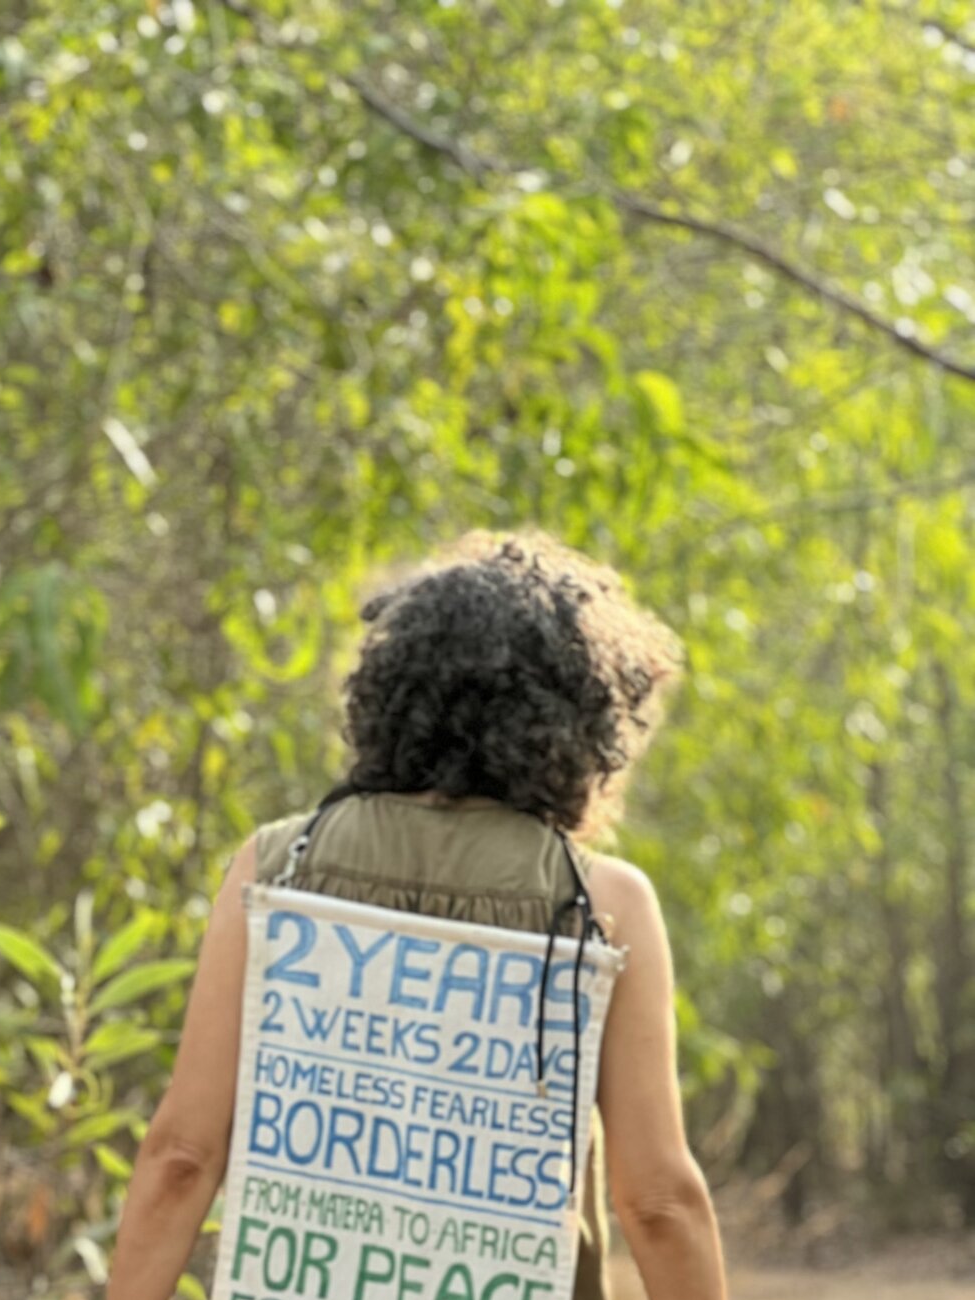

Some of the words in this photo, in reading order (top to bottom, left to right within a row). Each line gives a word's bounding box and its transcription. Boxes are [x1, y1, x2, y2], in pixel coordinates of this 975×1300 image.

[266, 911, 320, 988] 2
[335, 926, 596, 1034] YEARS
[260, 992, 285, 1033] 2
[293, 998, 440, 1064] WEEKS
[449, 1034, 480, 1074] 2
[487, 1039, 576, 1091] DAYS
[257, 1052, 405, 1109] HOMELESS
[413, 1088, 574, 1140] FEARLESS
[250, 1093, 569, 1210] BORDERLESS
[233, 1218, 337, 1298] FOR
[244, 1178, 300, 1218] FROM
[308, 1191, 383, 1235] MATERA
[395, 1207, 429, 1245] TO
[436, 1219, 556, 1268] AFRICA
